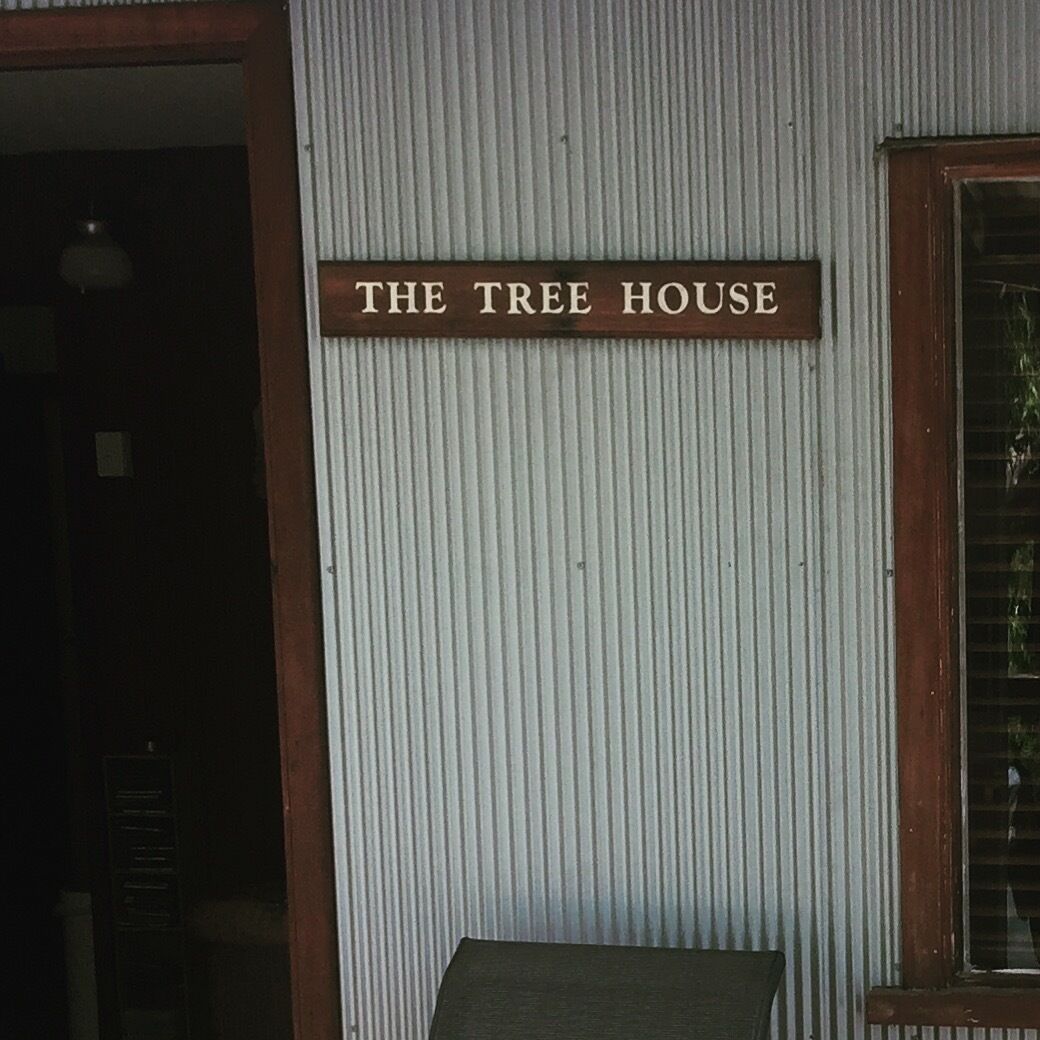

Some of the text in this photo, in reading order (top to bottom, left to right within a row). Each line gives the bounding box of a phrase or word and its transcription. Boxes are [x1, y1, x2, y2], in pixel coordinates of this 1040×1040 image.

[355, 281, 779, 315] THE TREE HOUSE
